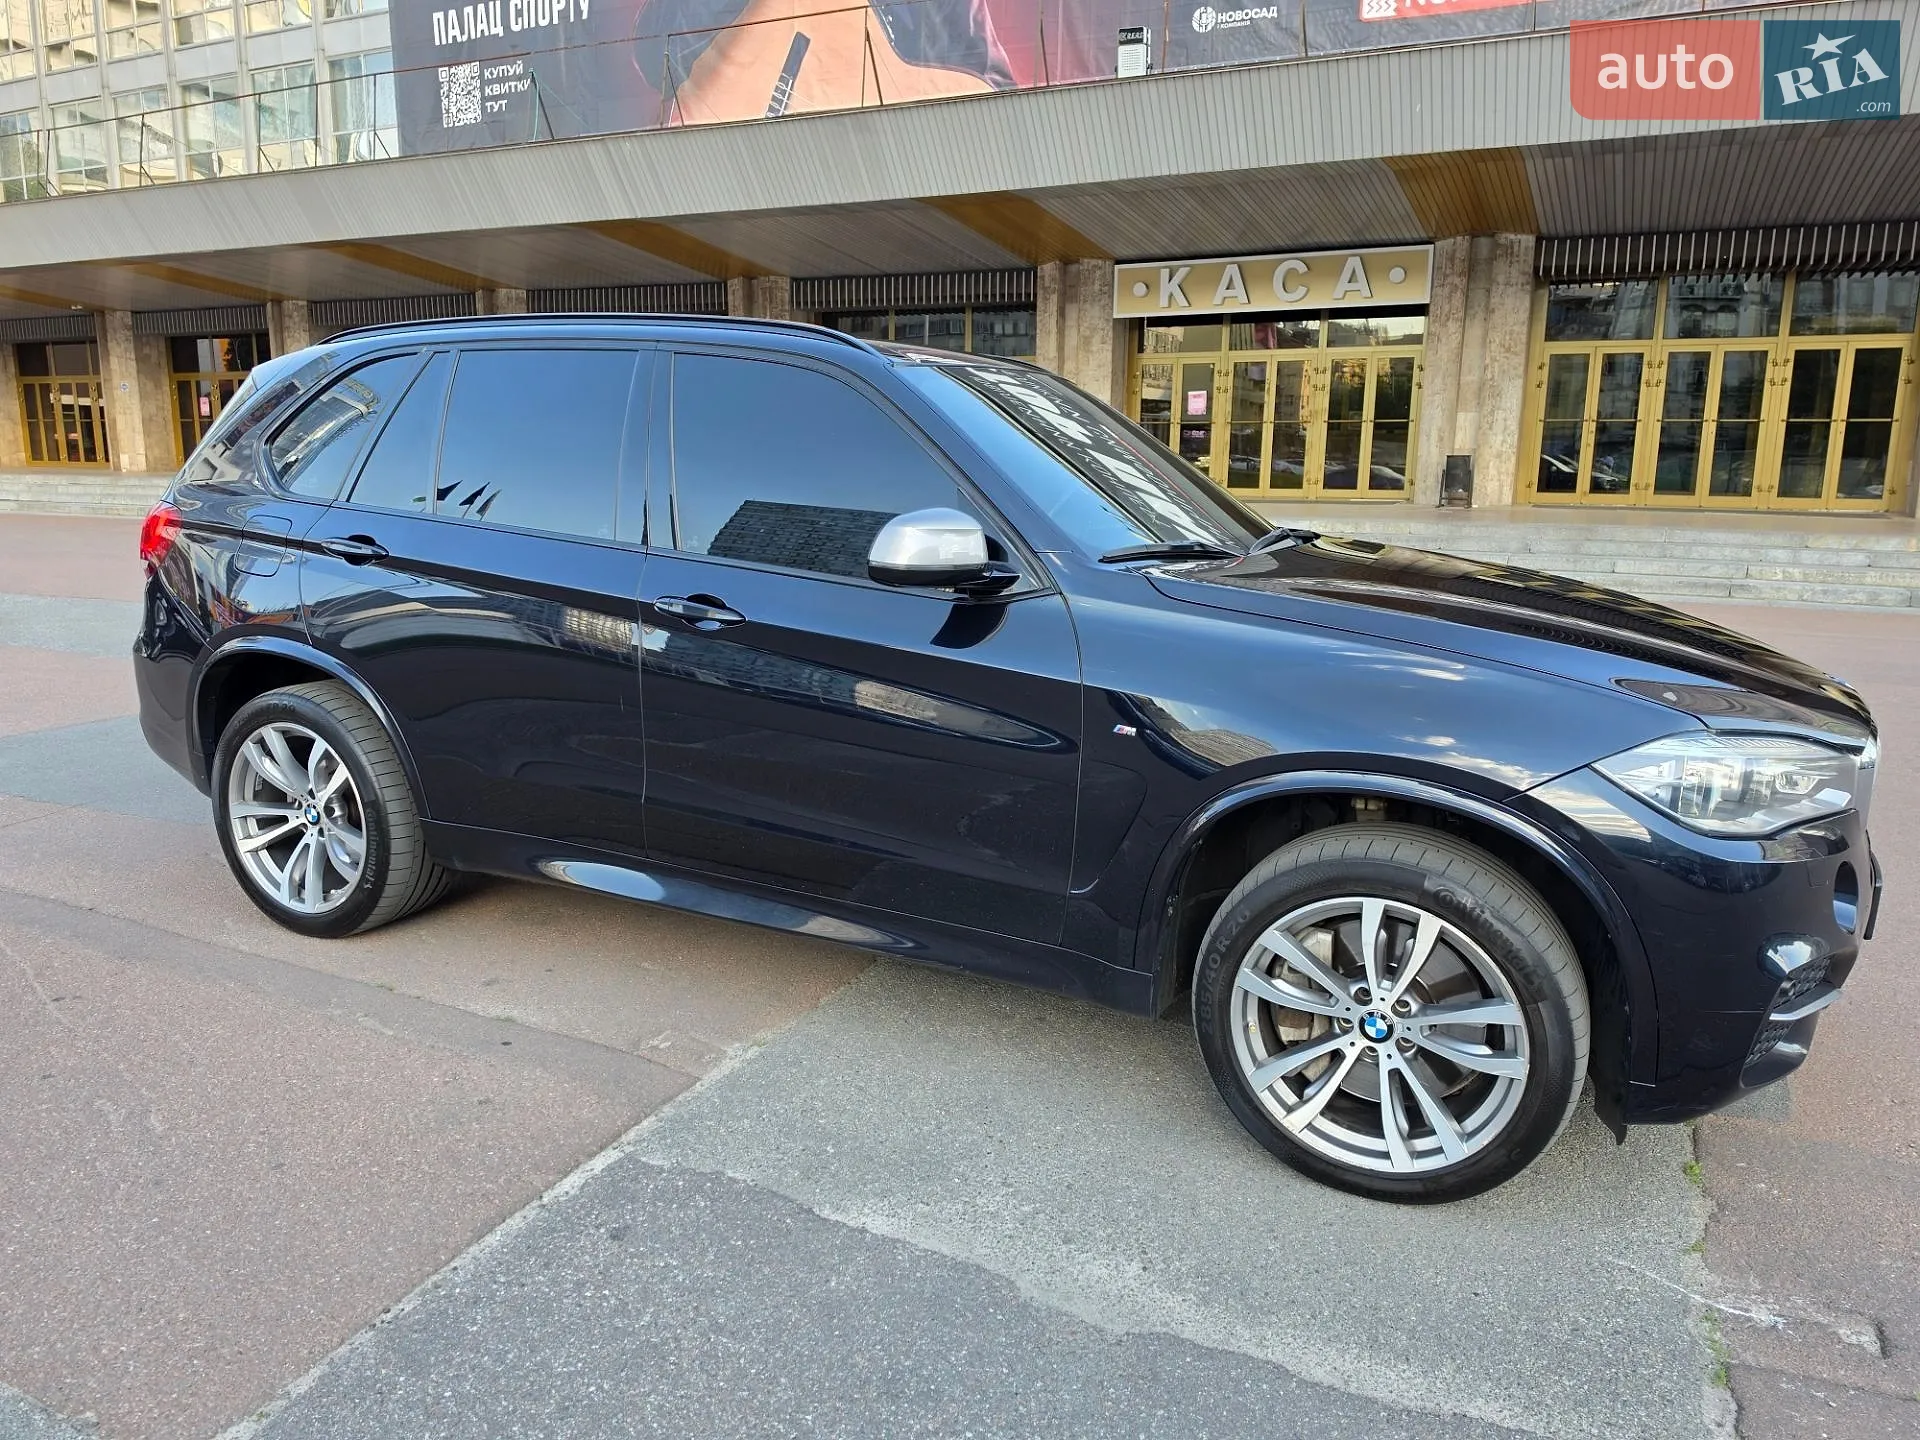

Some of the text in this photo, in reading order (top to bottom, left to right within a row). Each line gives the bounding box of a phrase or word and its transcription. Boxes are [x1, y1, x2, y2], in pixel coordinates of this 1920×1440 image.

[432, 0, 504, 46] ПАЛАЦ
[1217, 6, 1278, 23] НОВОСАД
[484, 60, 523, 80] КУПУЙ
[485, 78, 531, 97] КВИТКИ
[485, 99, 508, 113] ТУТ
[1158, 255, 1373, 308] КАСА
